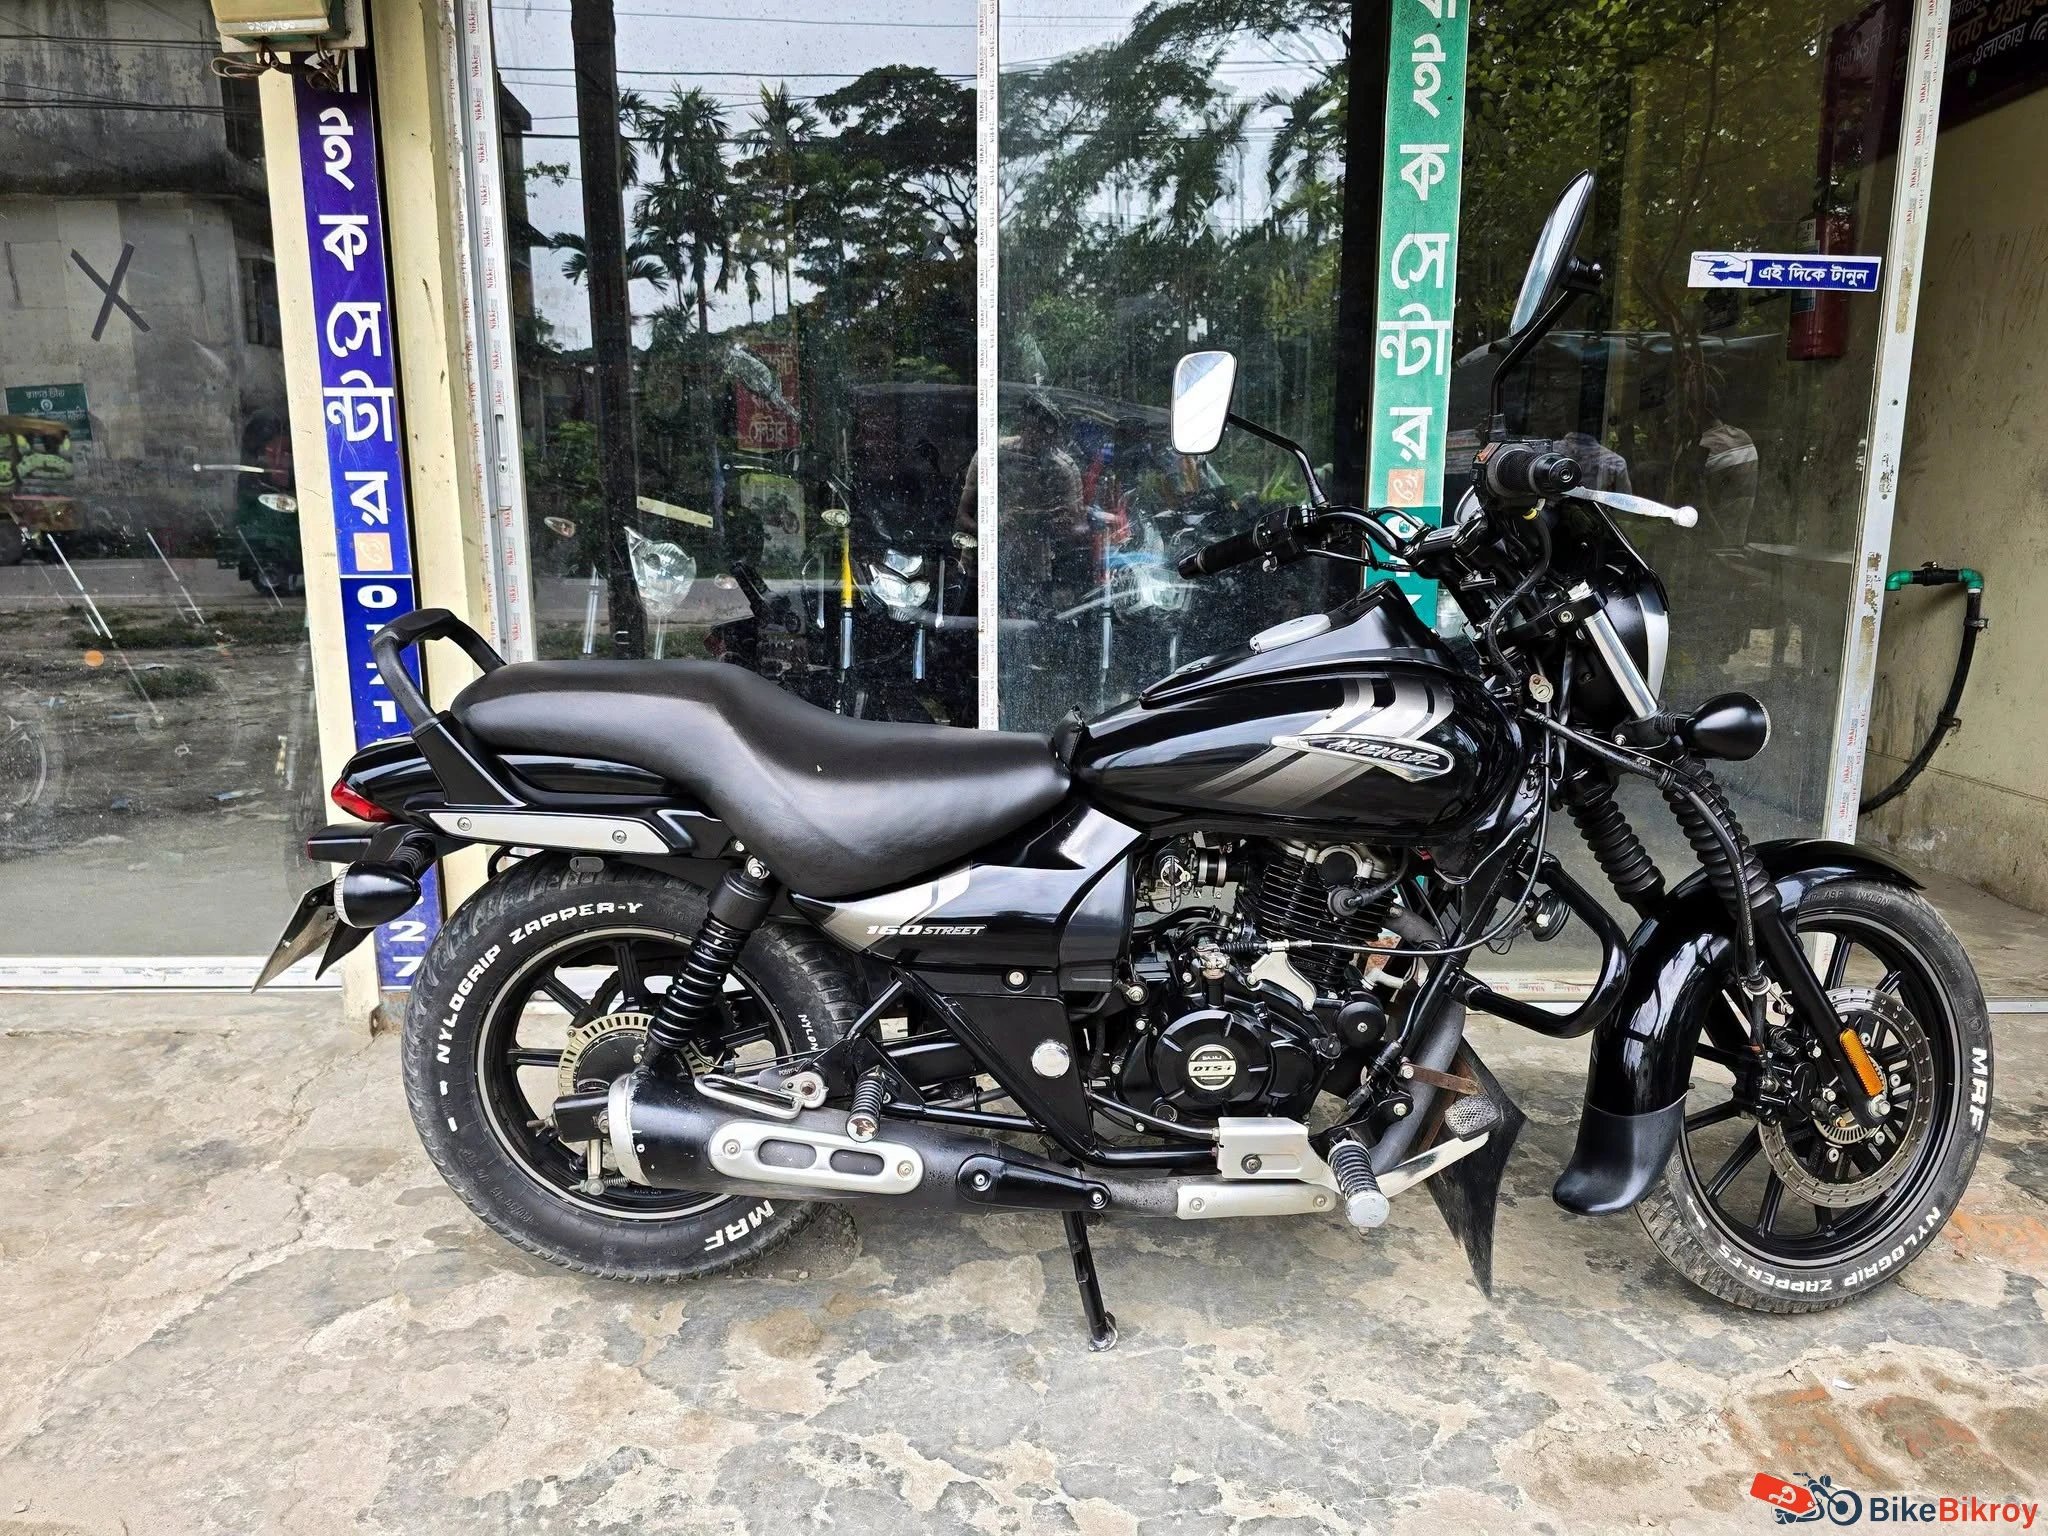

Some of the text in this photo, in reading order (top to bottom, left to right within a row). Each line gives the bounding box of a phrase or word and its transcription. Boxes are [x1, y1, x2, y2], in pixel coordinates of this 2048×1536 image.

[1759, 263, 1869, 287] এই দিকে টানুন
[1327, 739, 1440, 767] AVENGER
[1856, 890, 1890, 907] NYLON
[866, 925, 986, 935] 160 STREET
[437, 901, 644, 1065] NYLOGRIP ZAPPER-Y
[1970, 1047, 1987, 1132] MRF
[704, 1199, 774, 1253] MRF
[1844, 1206, 1941, 1288] NYLOGRIP
